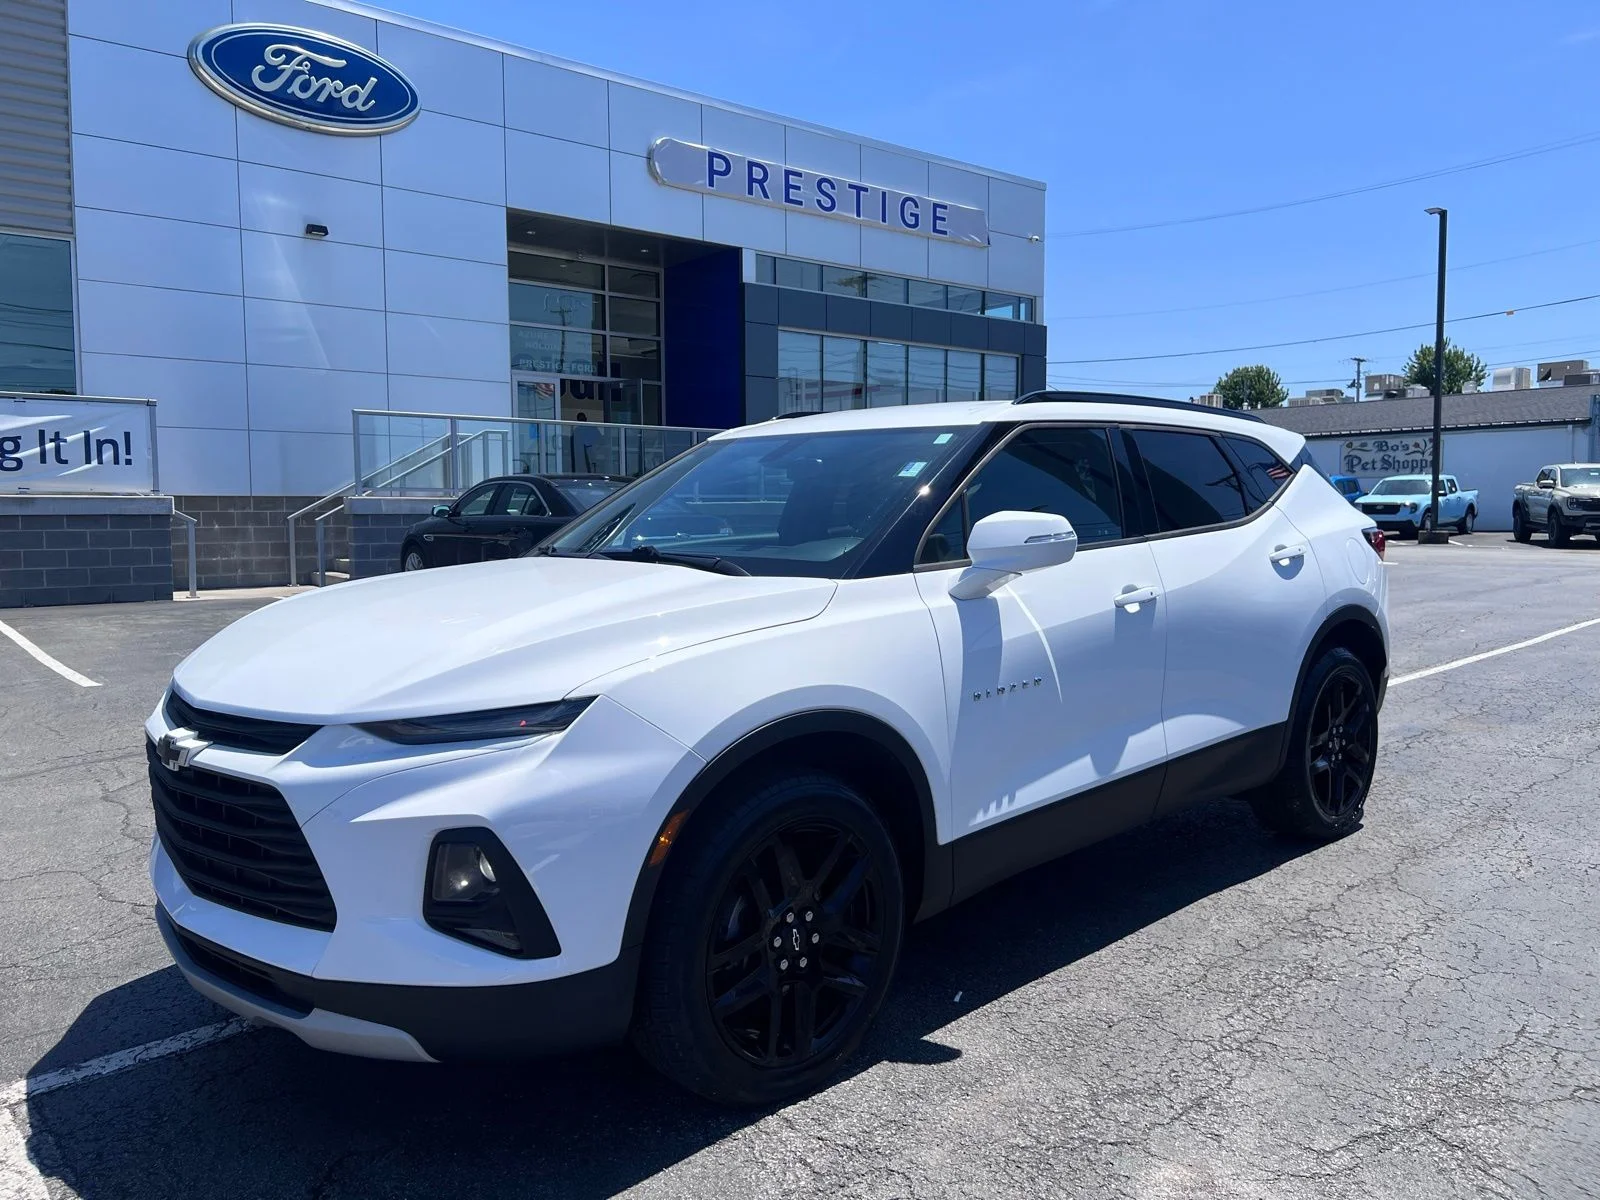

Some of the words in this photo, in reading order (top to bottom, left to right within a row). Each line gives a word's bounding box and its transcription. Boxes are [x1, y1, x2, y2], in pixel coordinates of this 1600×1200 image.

[251, 43, 378, 112] Ford
[707, 150, 949, 236] PRESTIGE
[519, 358, 570, 371] PRESTIGE
[571, 363, 598, 373] FORD
[38, 429, 69, 465] It
[83, 430, 133, 466] In!
[1372, 440, 1411, 452] Bo's
[1343, 454, 1377, 474] Pet
[1379, 454, 1433, 474] Shopp
